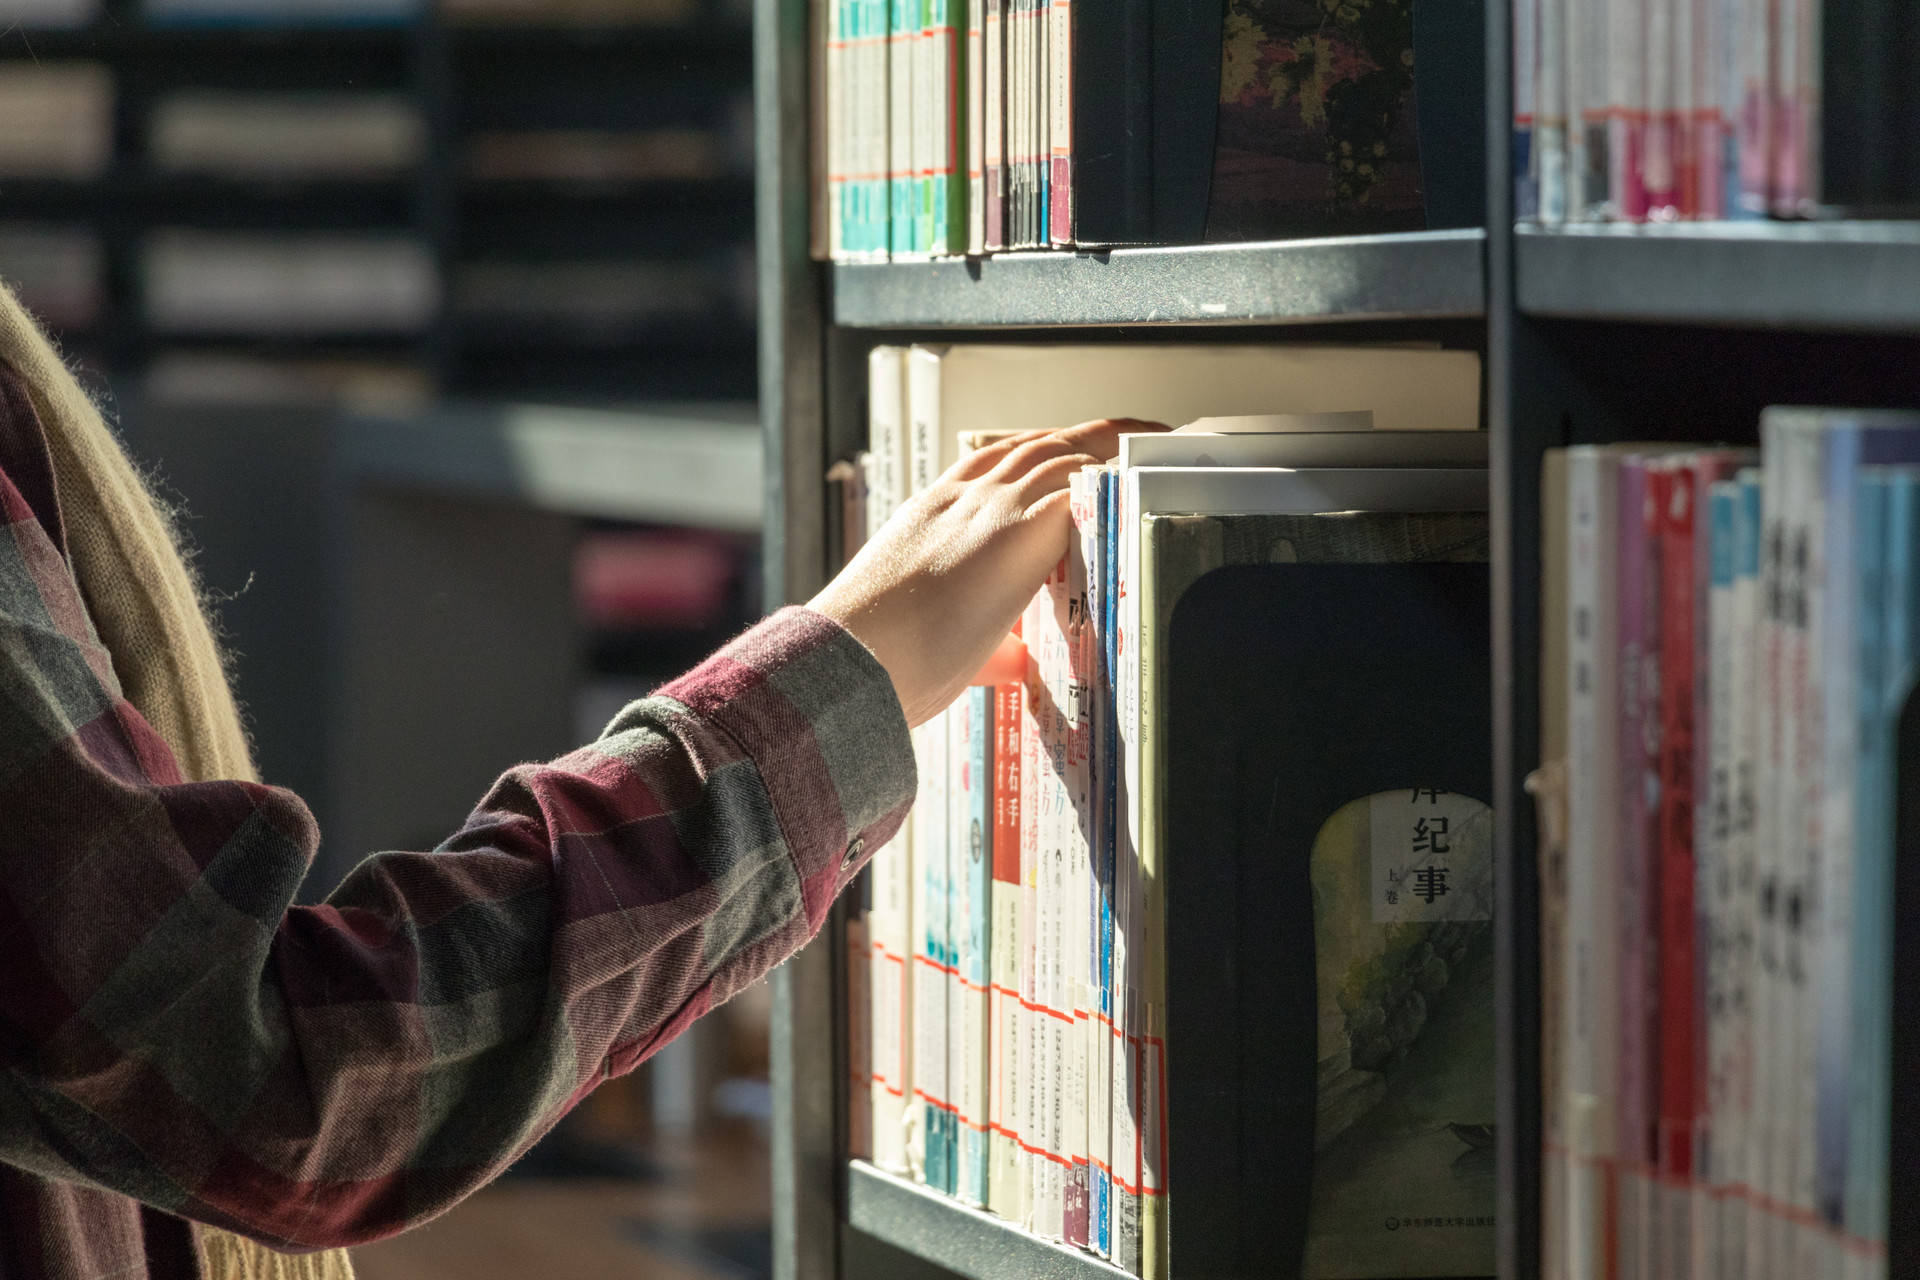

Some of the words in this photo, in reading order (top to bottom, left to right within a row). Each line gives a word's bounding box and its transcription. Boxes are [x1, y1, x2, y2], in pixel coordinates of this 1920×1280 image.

[1008, 681, 1020, 828] 手和右手
[1385, 868, 1399, 905] 上卷
